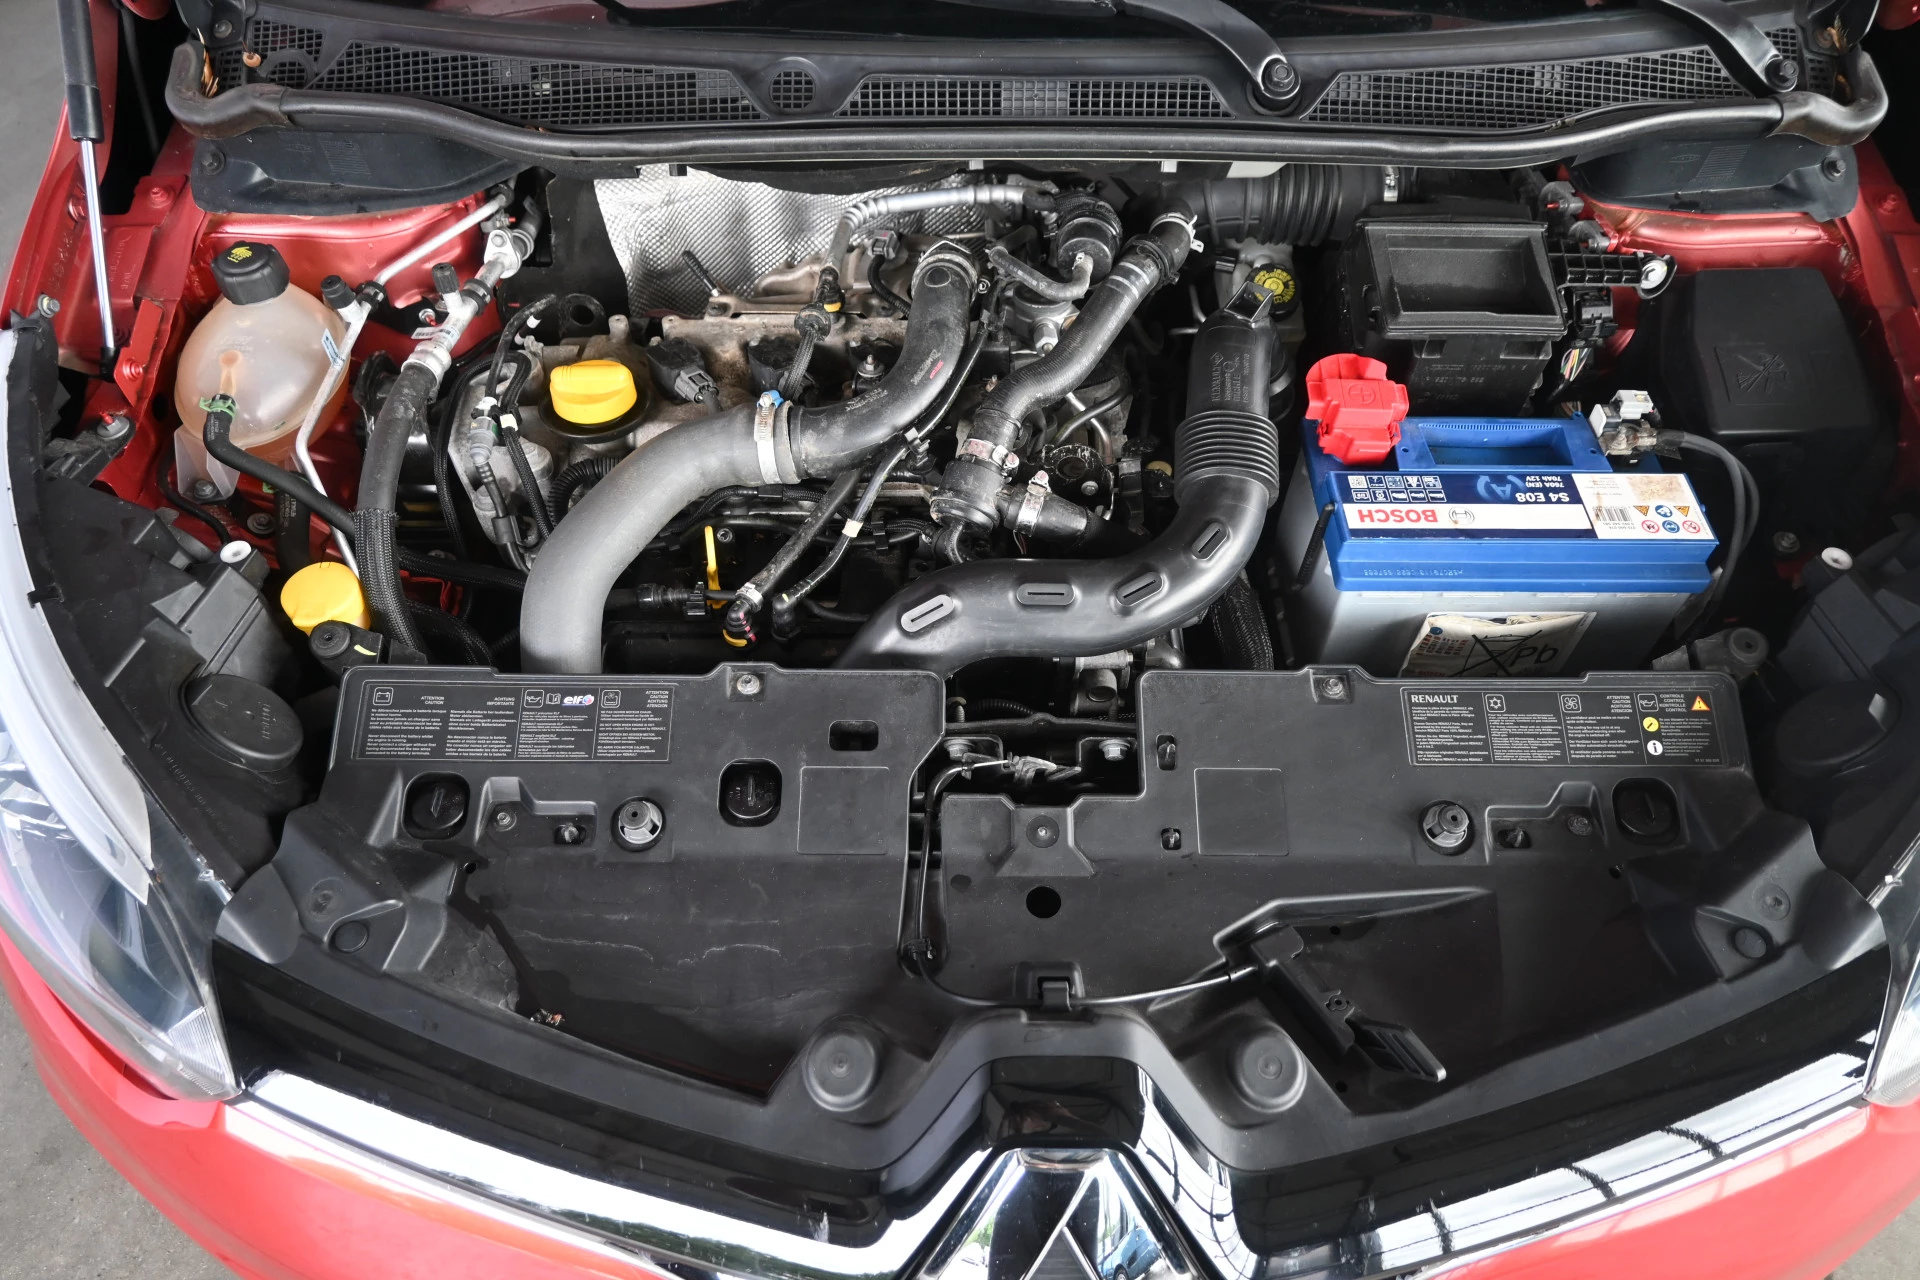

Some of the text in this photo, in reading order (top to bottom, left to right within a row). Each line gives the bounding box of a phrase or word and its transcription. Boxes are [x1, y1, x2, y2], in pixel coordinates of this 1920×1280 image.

[1515, 492, 1570, 502] S4 E08
[1357, 509, 1438, 523] BOSCH
